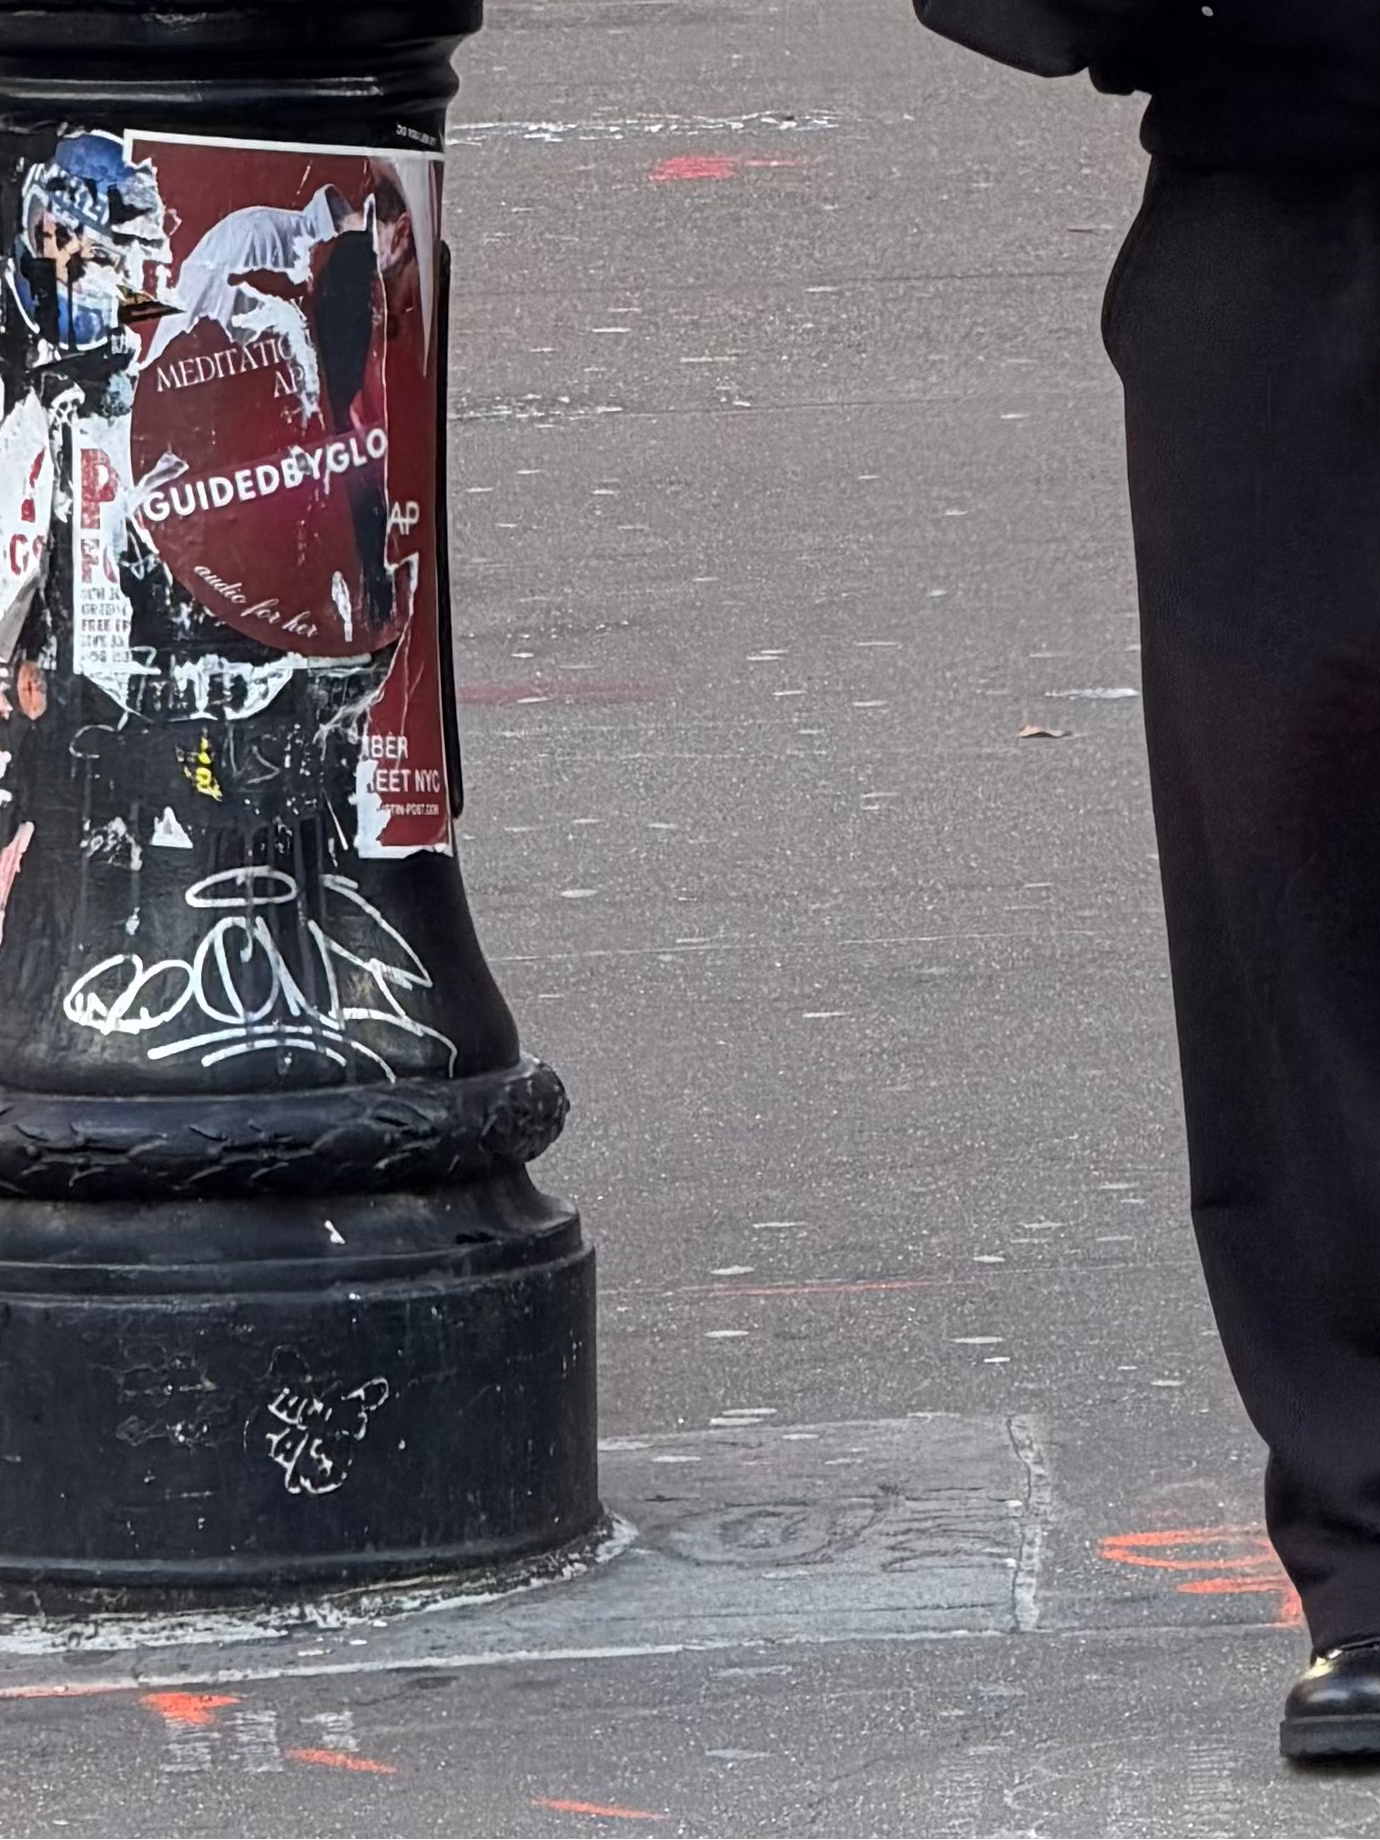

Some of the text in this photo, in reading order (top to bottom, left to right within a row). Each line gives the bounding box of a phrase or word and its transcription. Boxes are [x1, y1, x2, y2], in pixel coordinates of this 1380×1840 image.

[141, 427, 388, 523] GUIDEDBYGLO
[193, 565, 319, 638] audio for her
[414, 768, 441, 794] NYC
